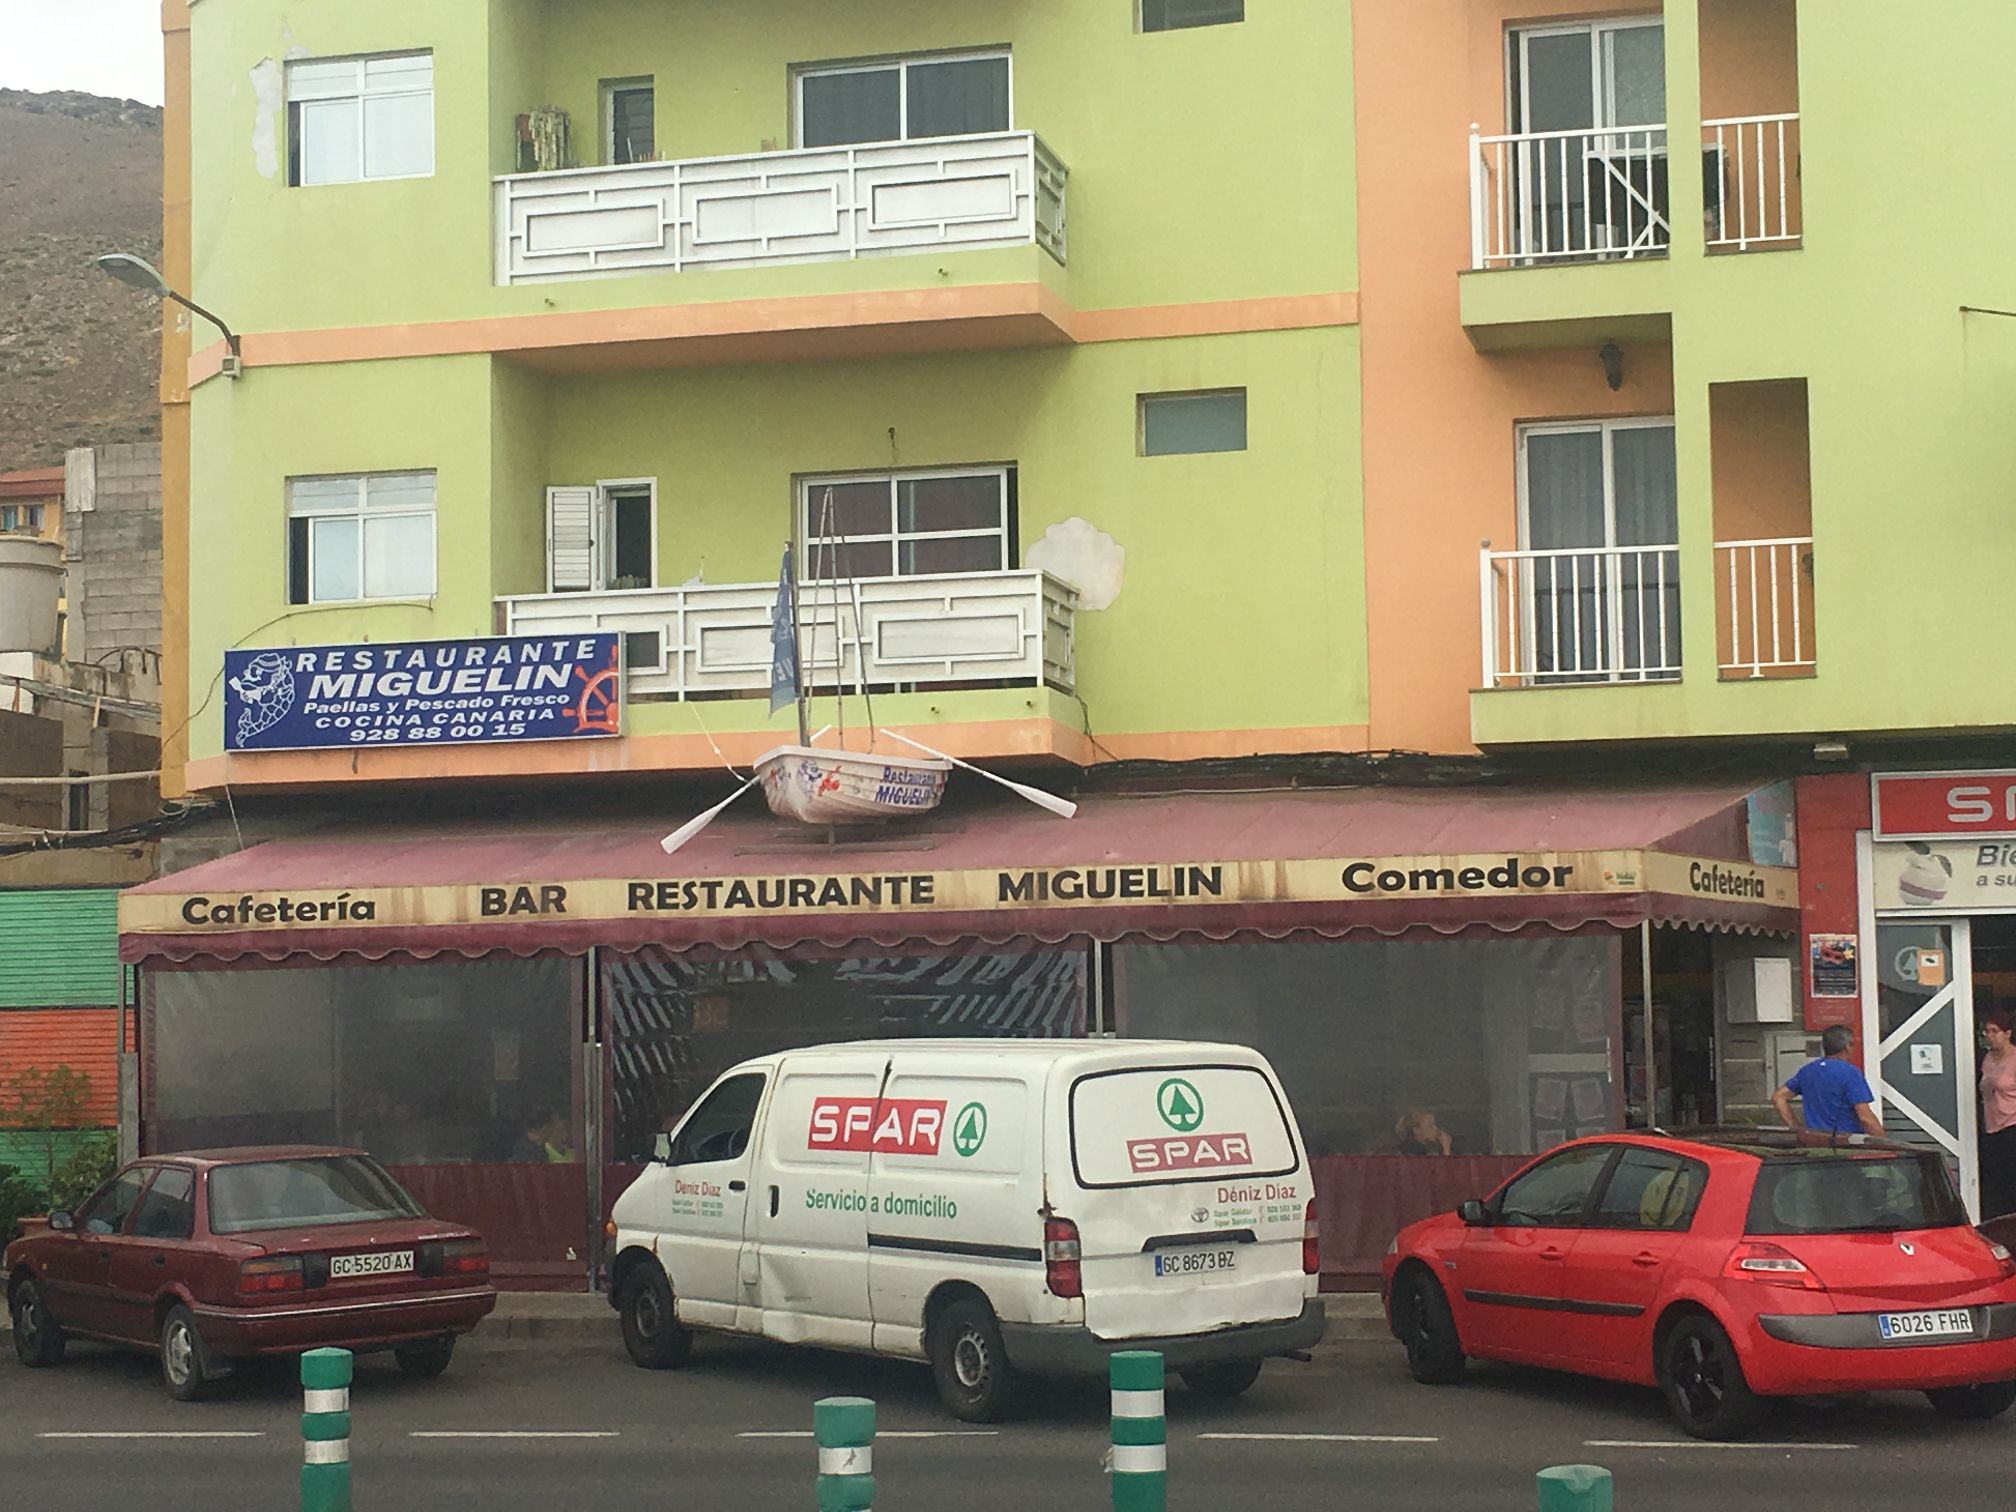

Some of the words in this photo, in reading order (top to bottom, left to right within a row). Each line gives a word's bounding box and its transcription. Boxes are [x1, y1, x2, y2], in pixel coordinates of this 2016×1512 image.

[296, 639, 595, 672] RESTAURANTE
[308, 663, 572, 700] MIGUELIN
[303, 700, 380, 715] Paellas
[386, 703, 397, 714] y
[405, 696, 493, 712] Pescado
[500, 692, 570, 708] Fresco
[315, 713, 423, 729] COCINA
[432, 707, 555, 725] CANARIA
[349, 728, 400, 742] 928
[407, 726, 443, 741] 88
[450, 724, 483, 738] 00
[491, 722, 526, 737] 15
[1947, 786, 2016, 822] S
[182, 893, 376, 925] Cafetería
[481, 885, 567, 917] BAR
[627, 875, 935, 911] RESTAURANTE
[997, 866, 1223, 902] MIGUELIN
[1342, 858, 1573, 893] Comedor
[1689, 861, 1765, 899] Cafetería
[1976, 874, 1988, 887] a
[811, 1105, 942, 1147] SPAR
[1132, 1137, 1249, 1168] SPAR
[805, 1188, 866, 1212] Servicio
[870, 1195, 879, 1213] a
[884, 1191, 958, 1219] domicilio
[1890, 1315, 1933, 1334] 6026
[1938, 1312, 1970, 1331] FHR
